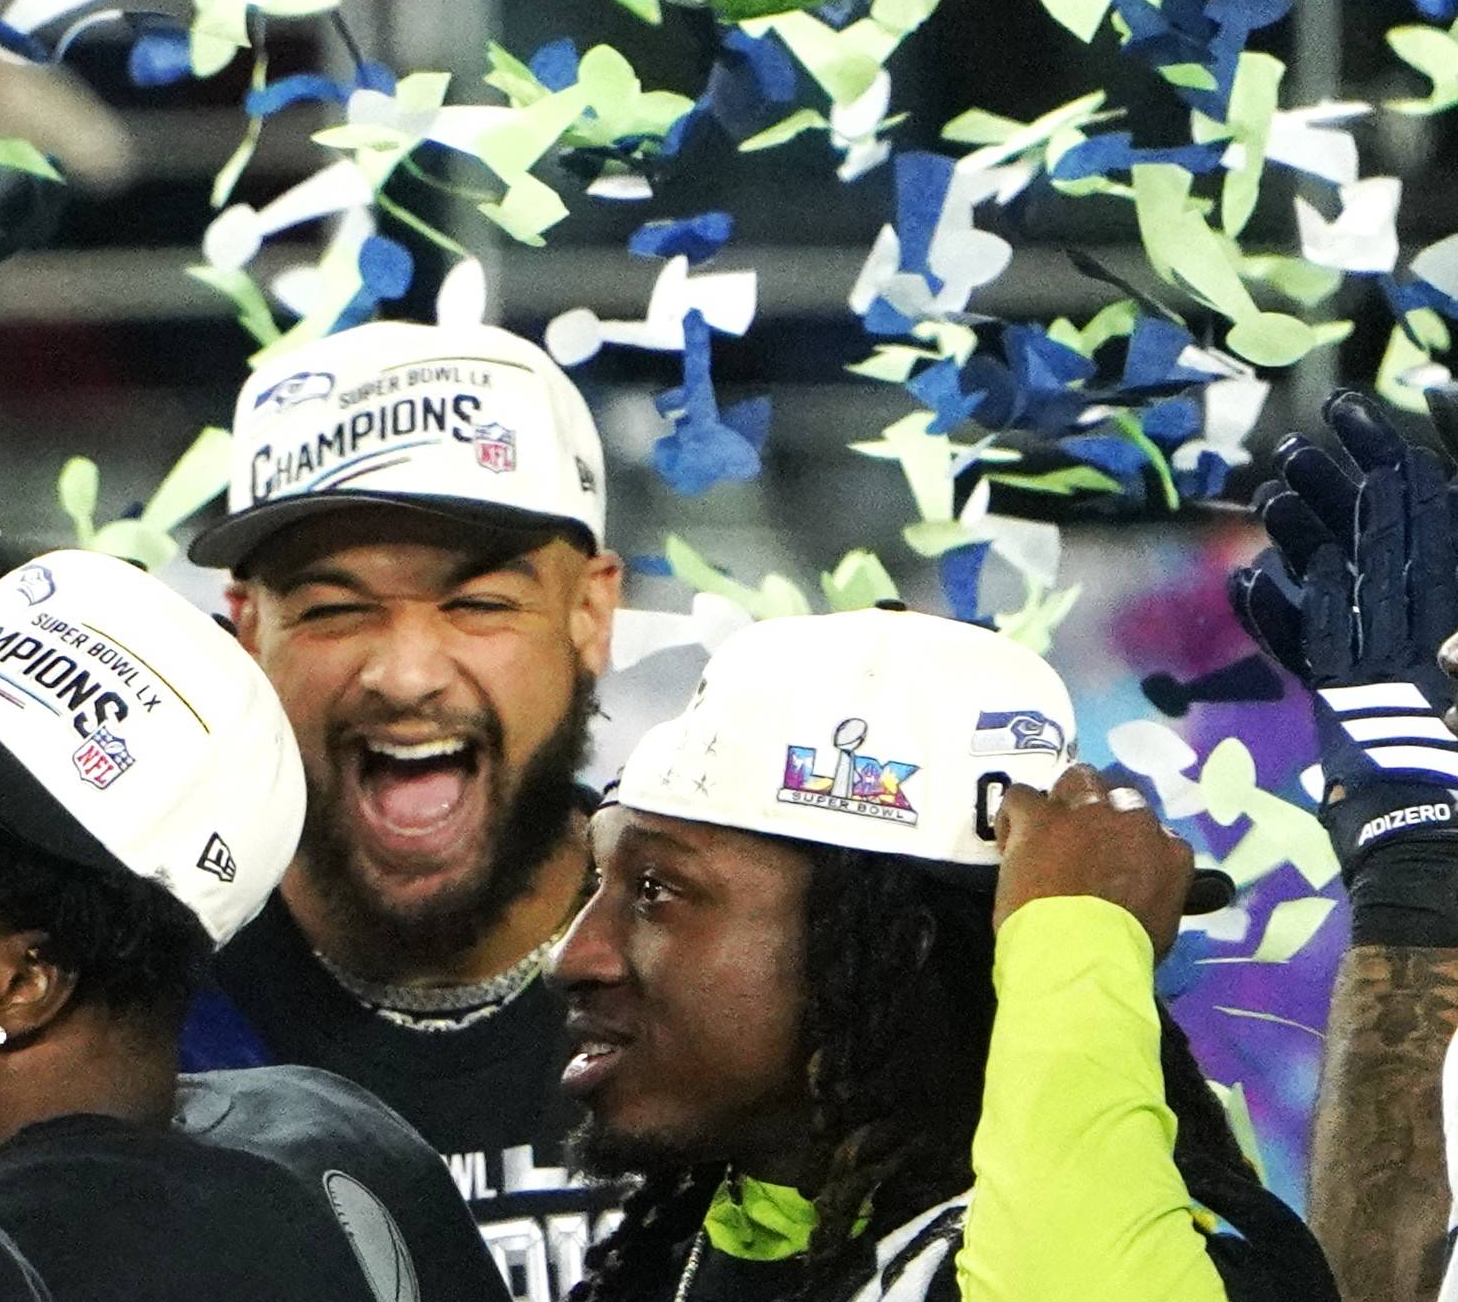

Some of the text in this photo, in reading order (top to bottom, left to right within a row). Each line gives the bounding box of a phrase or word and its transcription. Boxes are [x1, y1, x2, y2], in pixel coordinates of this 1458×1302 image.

[338, 367, 494, 410] SUPER BOWL LX
[251, 393, 483, 501] CHAMPIONS
[481, 442, 513, 472] NFL
[30, 612, 163, 714] SUPER BOWL LX
[76, 745, 115, 786] NFL
[791, 790, 905, 820] SUPER BOWL
[1358, 803, 1451, 847] ADIZERO
[502, 1143, 589, 1194] L
